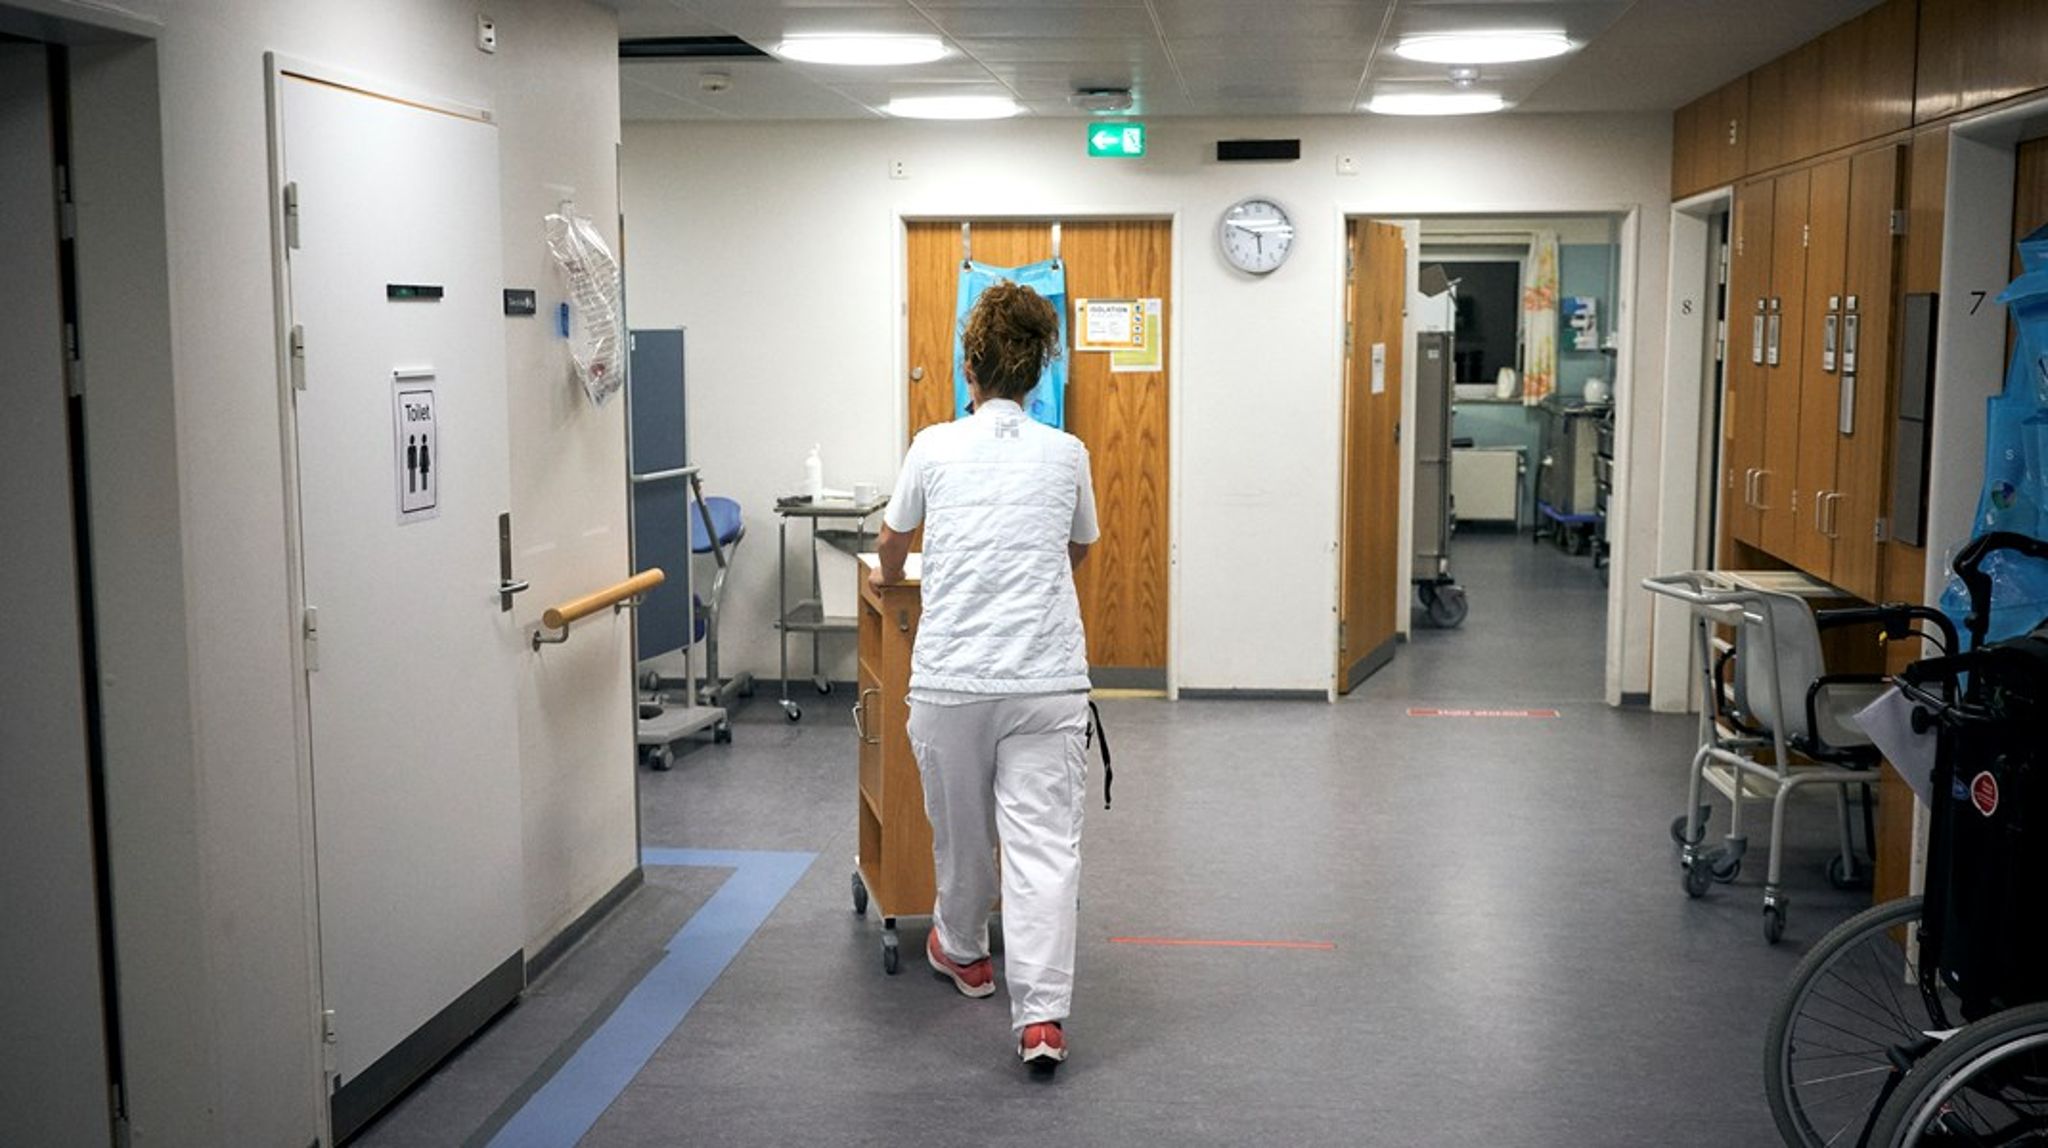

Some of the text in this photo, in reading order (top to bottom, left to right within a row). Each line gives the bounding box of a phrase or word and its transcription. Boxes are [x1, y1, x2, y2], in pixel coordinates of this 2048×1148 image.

[1682, 299, 1693, 315] 8
[1970, 291, 1986, 315] 7
[405, 404, 431, 422] Toilet
